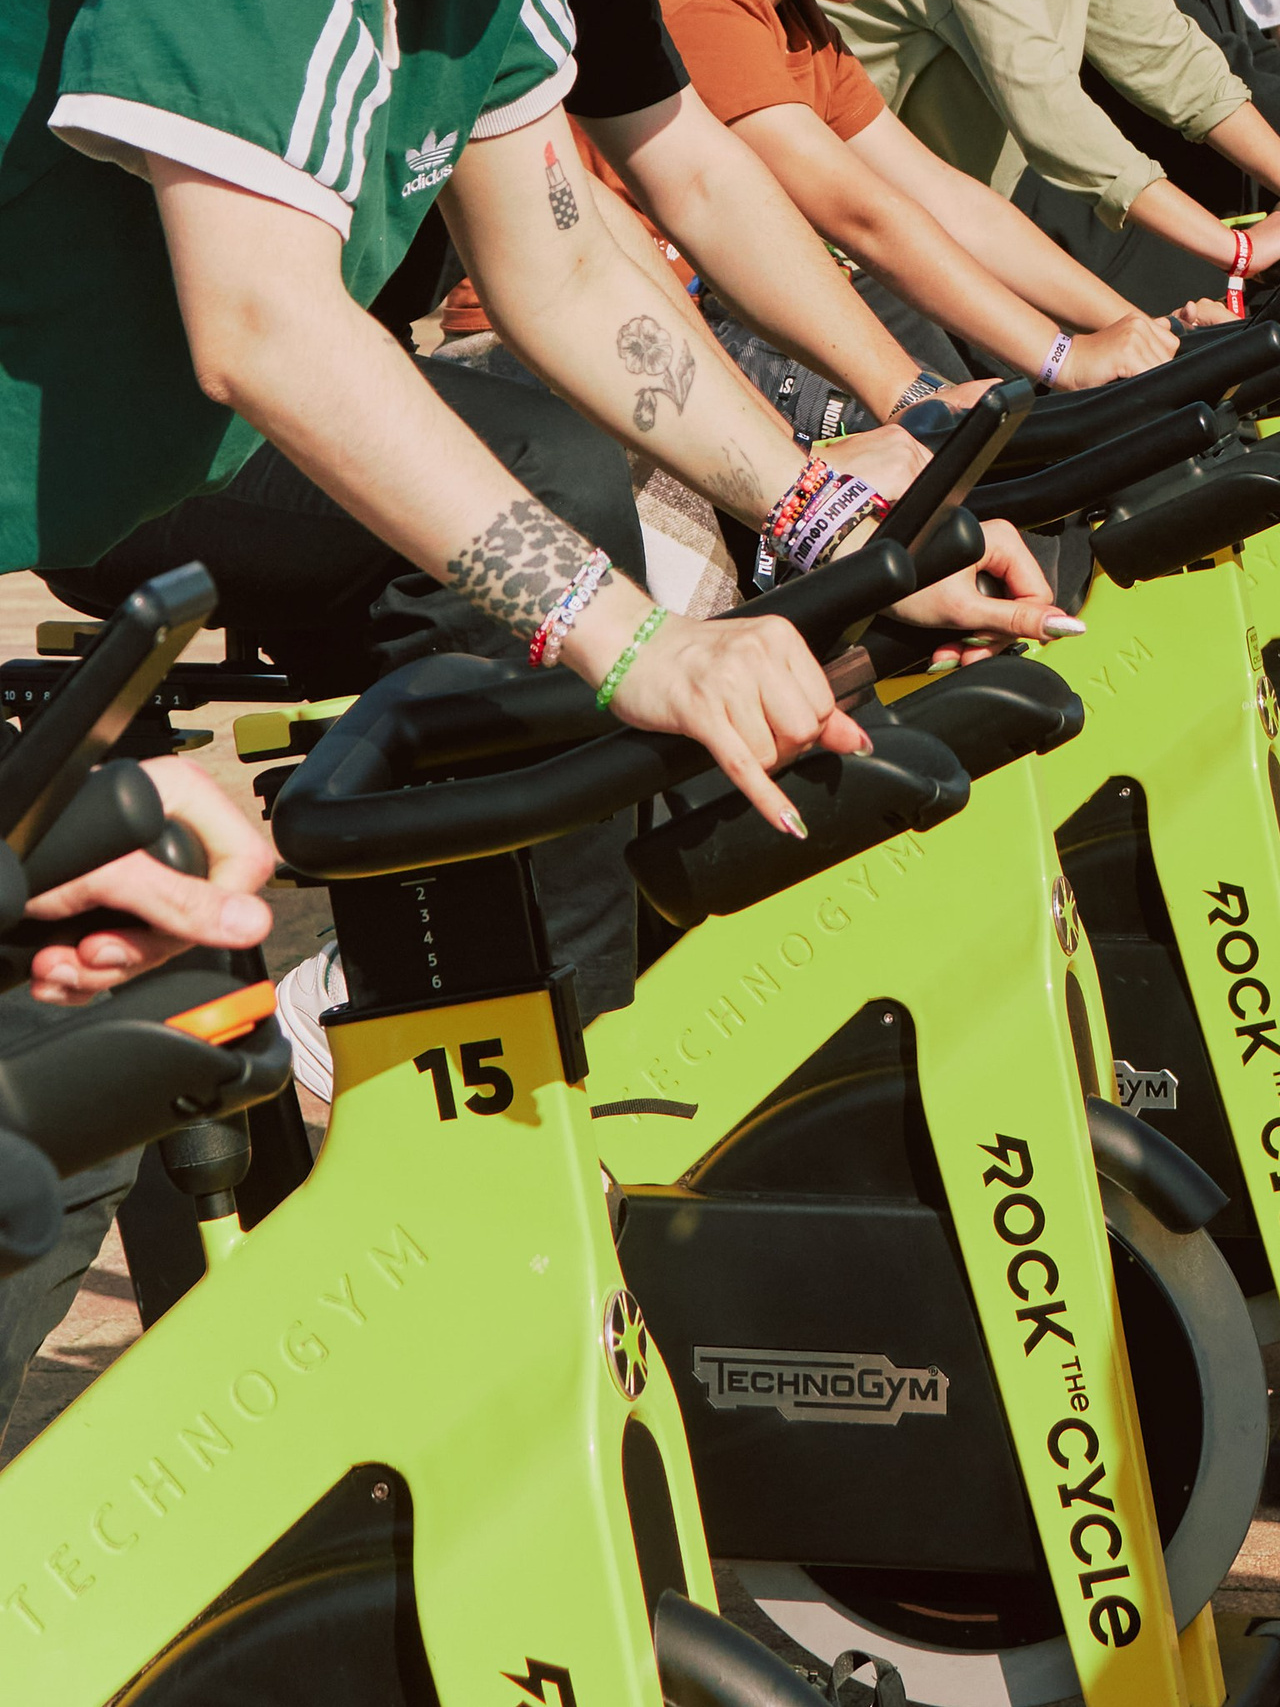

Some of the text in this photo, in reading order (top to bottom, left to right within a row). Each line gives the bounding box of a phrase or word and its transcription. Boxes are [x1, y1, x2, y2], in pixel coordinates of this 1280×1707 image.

[401, 163, 454, 198] adidas
[1051, 342, 1066, 364] 2025
[4, 690, 16, 701] 10
[25, 690, 33, 701] 9
[154, 694, 162, 705] 2
[173, 695, 180, 705] 1
[415, 886, 426, 901] 2
[420, 908, 430, 923] 3
[423, 930, 434, 944] 4
[427, 953, 438, 967] 5
[431, 975, 442, 989] 6
[412, 1038, 514, 1122] 15
[977, 1133, 1076, 1357] ROCK
